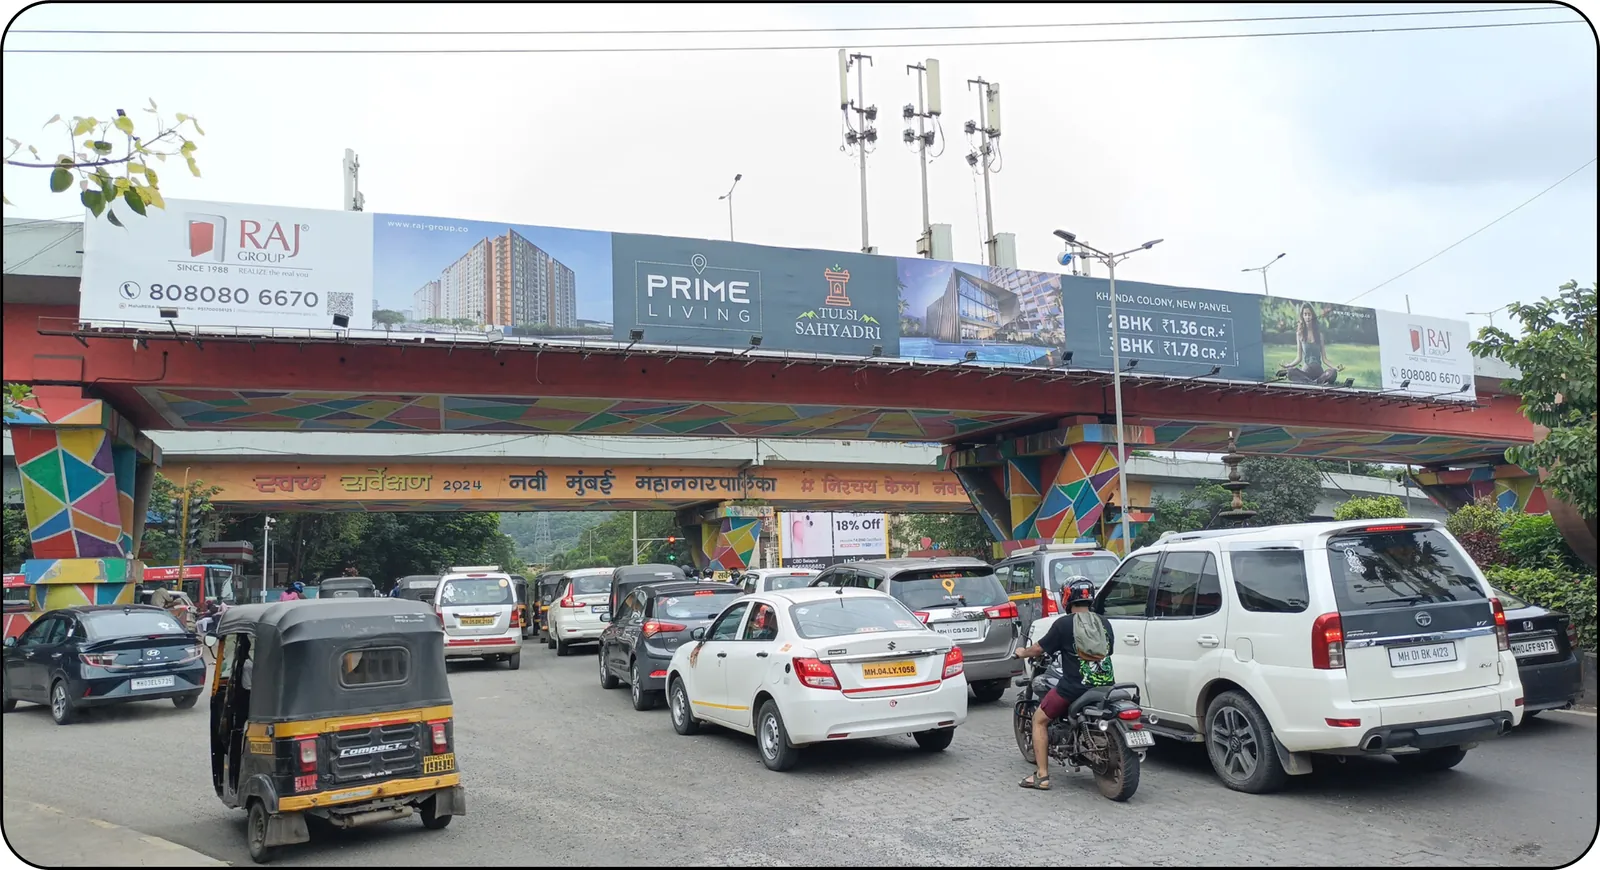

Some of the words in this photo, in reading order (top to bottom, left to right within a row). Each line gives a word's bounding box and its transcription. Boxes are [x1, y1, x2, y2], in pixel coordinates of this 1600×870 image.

[387, 221, 469, 233] www.raj-group.co
[237, 251, 285, 263] GROUP
[177, 263, 204, 272] SINCE
[207, 265, 229, 274] 1988
[238, 267, 267, 277] REALIZE
[269, 269, 280, 277] the
[281, 270, 295, 278] real
[149, 283, 249, 304] 808080
[258, 289, 319, 308] 6670
[647, 274, 750, 304] PRIME
[1136, 295, 1175, 309] COLONY,
[1176, 300, 1197, 309] NEW
[1198, 302, 1232, 313] PANVEL
[648, 303, 751, 323] LIVING
[818, 307, 859, 321] TULSI
[794, 321, 882, 341] SAHYADRI
[1119, 315, 1153, 332] BHK
[1120, 337, 1154, 354] BHK
[1427, 328, 1451, 353] RAJ
[1400, 368, 1437, 382] 808080
[1439, 372, 1461, 385] 6670
[254, 474, 327, 493] स्वच्छ
[340, 468, 433, 492] सर्वेक्षण
[442, 480, 482, 493] 2024
[508, 470, 548, 492] नवी
[565, 470, 616, 496] मुंबई
[635, 472, 778, 493] महानगरपालिका
[821, 473, 878, 496] निश्चय
[884, 475, 920, 495] केला
[836, 520, 860, 531] 18%
[1397, 651, 1411, 661] MH
[1412, 650, 1420, 660] 01
[1421, 649, 1432, 659] BK
[1432, 647, 1449, 658] 4123
[864, 665, 915, 676] MH.04.LY.1058
